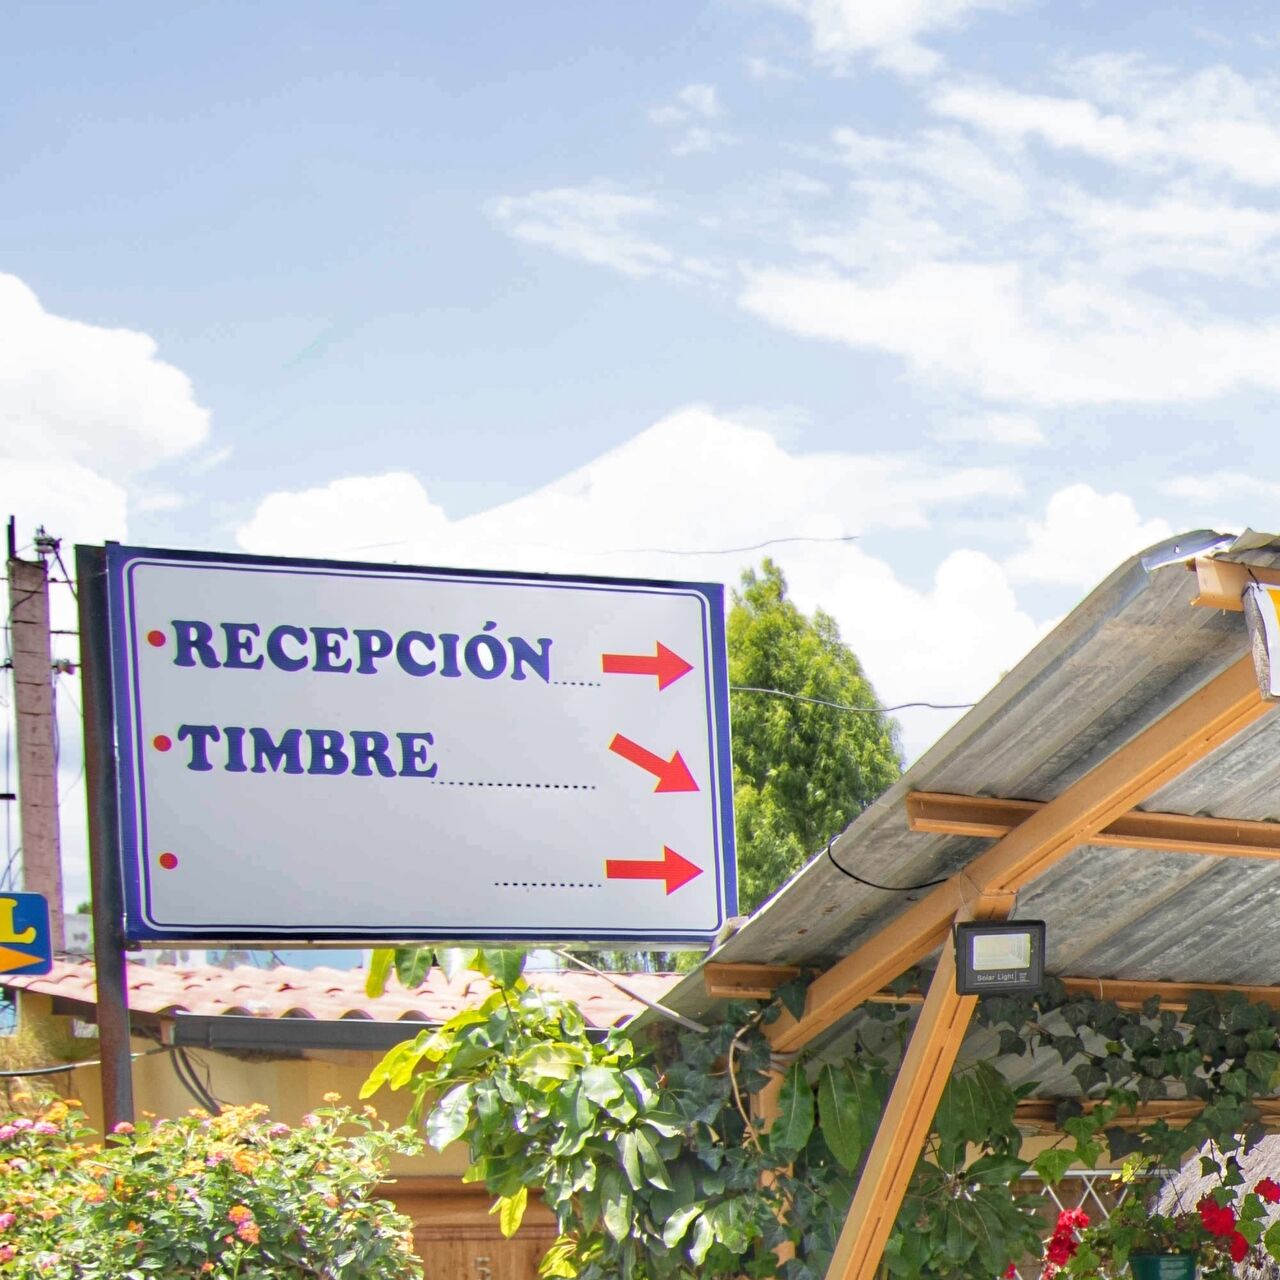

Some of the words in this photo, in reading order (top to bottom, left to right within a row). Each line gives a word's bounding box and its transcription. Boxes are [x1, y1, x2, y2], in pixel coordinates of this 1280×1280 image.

[171, 620, 553, 684] RECEPCIÓN
[177, 724, 438, 779] TIMBRE
[997, 973, 1014, 981] Light
